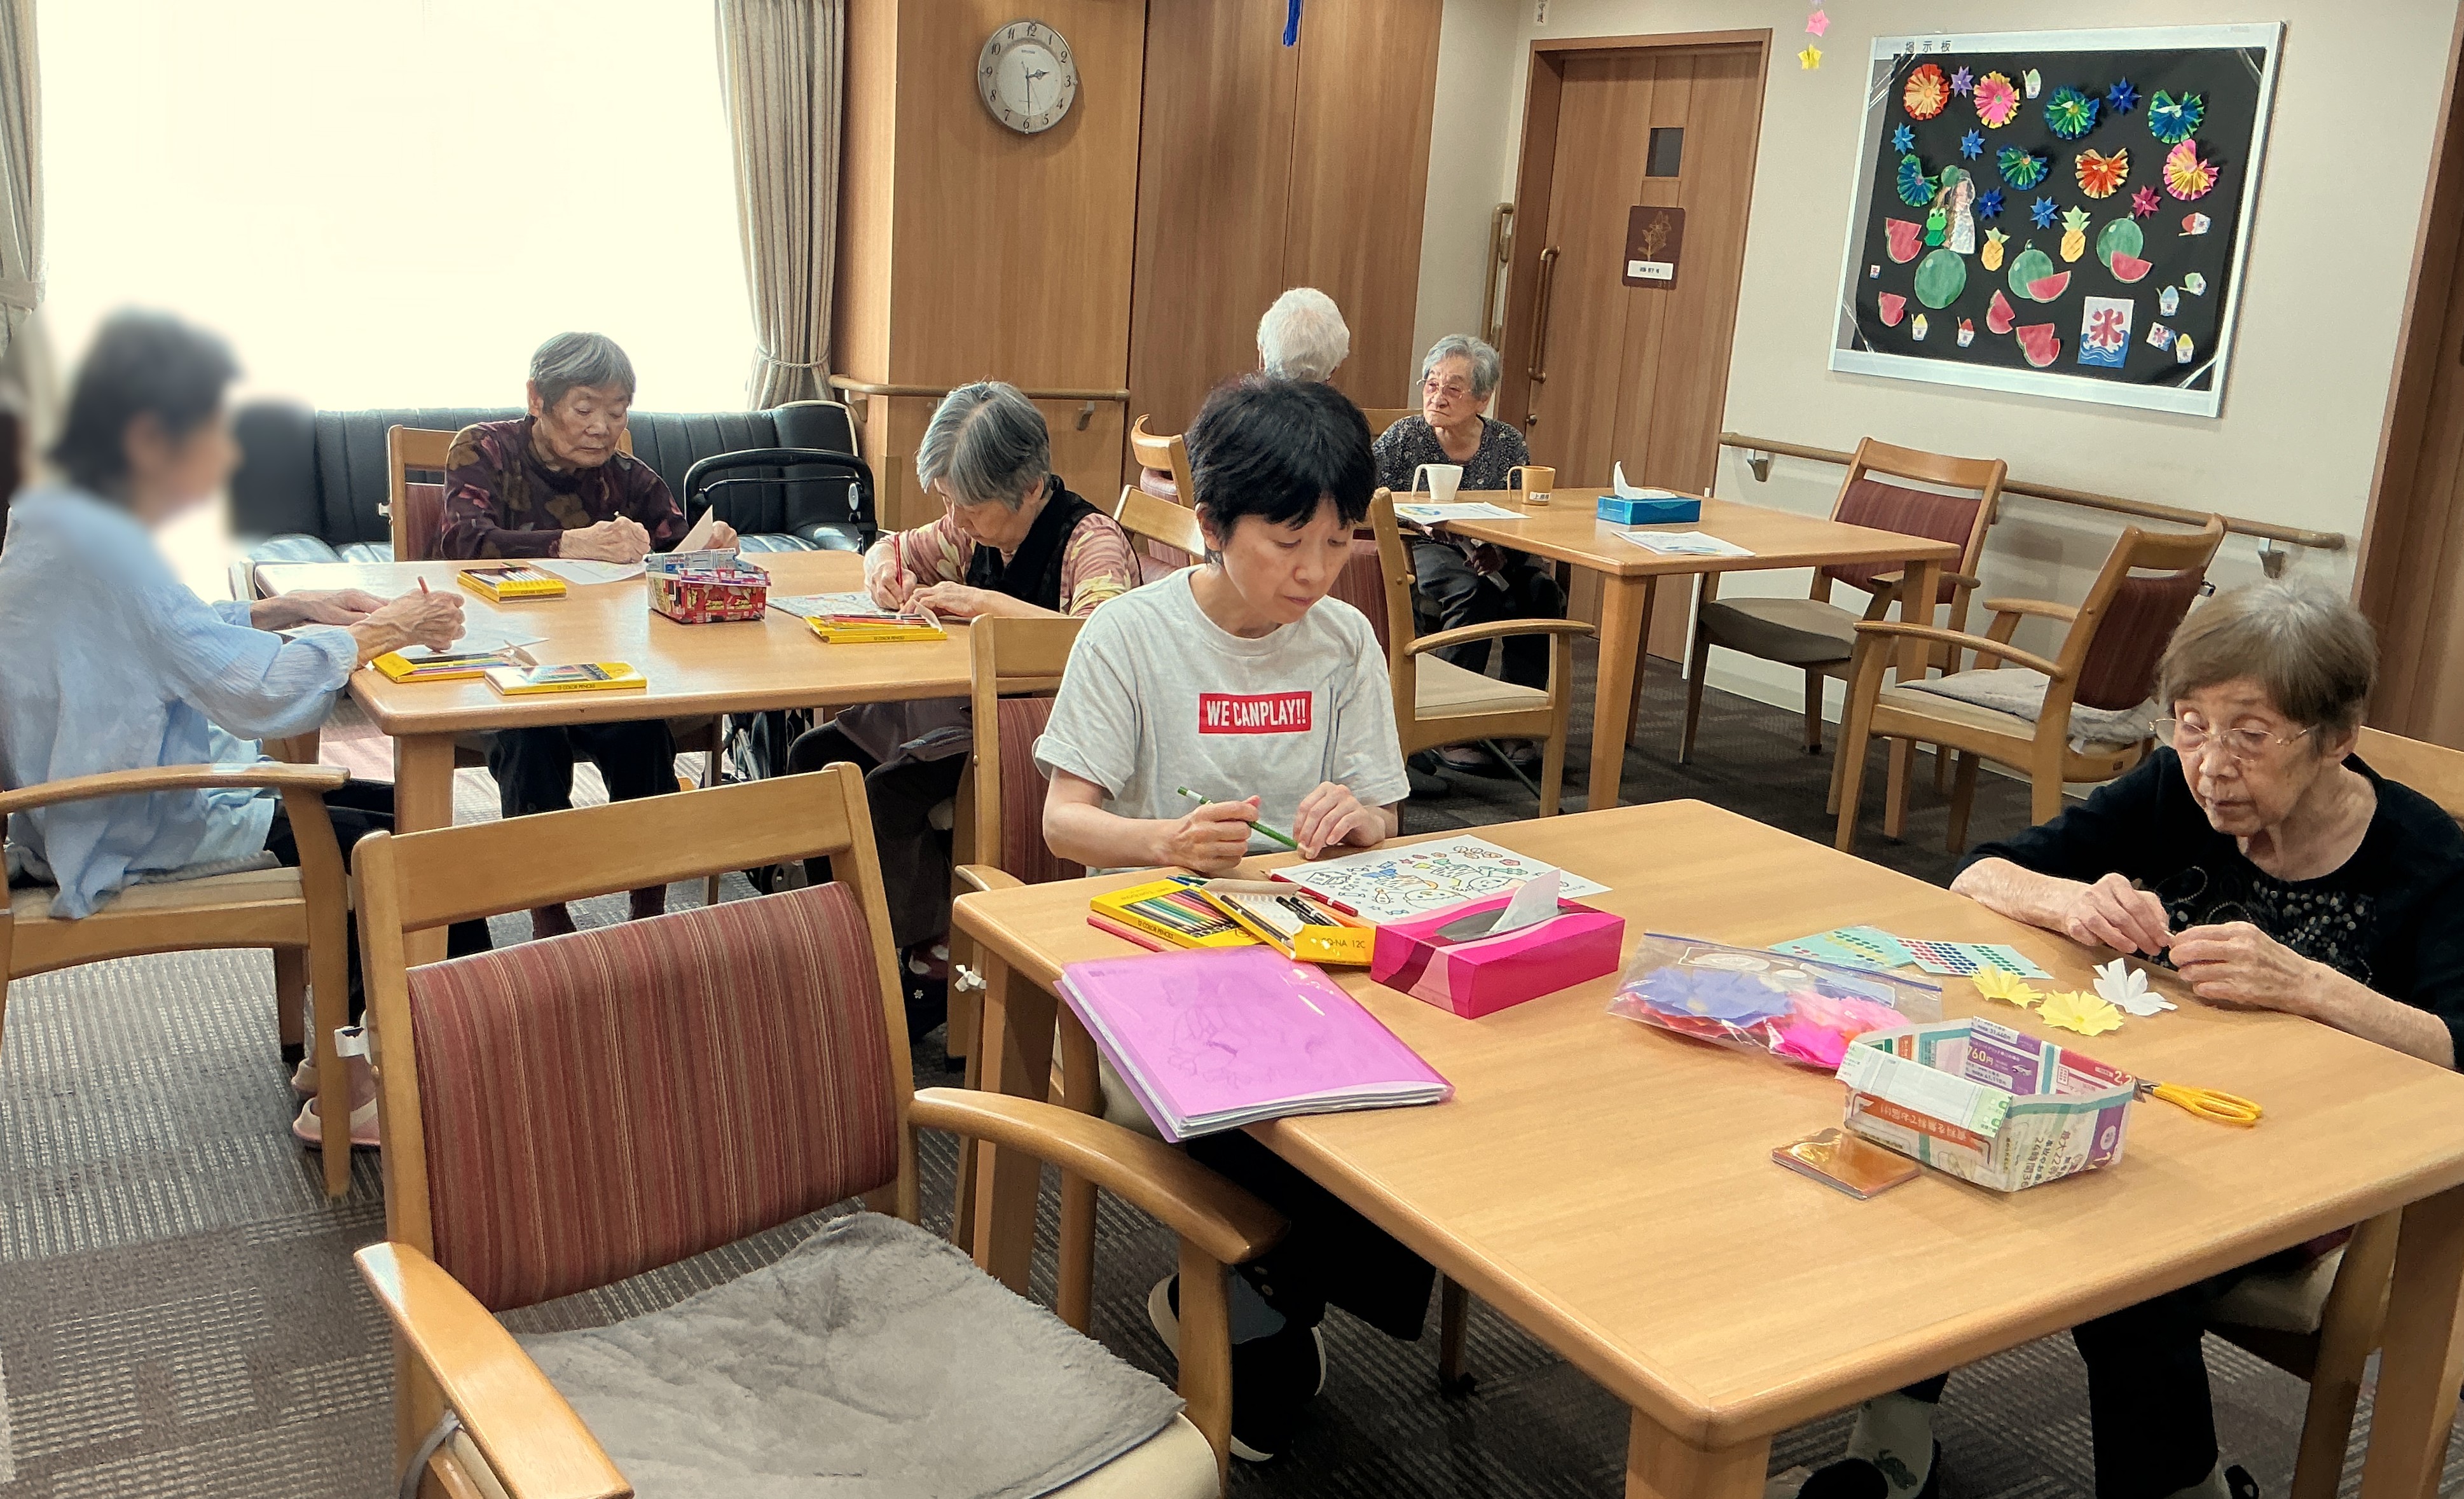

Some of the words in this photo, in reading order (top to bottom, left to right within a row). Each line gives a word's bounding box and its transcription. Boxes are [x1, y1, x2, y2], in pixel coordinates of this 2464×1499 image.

[1008, 27, 1015, 39] 11
[1026, 25, 1037, 37] 12
[1049, 34, 1053, 45] 1
[991, 43, 1001, 55] 10
[1906, 40, 1951, 54] 掲示板
[1061, 51, 1068, 63] 2
[986, 66, 993, 76] 9
[1064, 75, 1071, 88] 3
[990, 90, 996, 102] 8
[1057, 98, 1064, 109] 4
[1004, 109, 1010, 121] 7
[1042, 114, 1049, 125] 5
[1022, 118, 1030, 130] 6
[2089, 308, 2124, 347] 氷
[1206, 700, 1230, 726] WE
[1232, 698, 1306, 727] CANPLAY!!
[1142, 922, 1157, 934] COLOR
[1157, 927, 1174, 940] PENCILS
[1352, 940, 1365, 948] 12C
